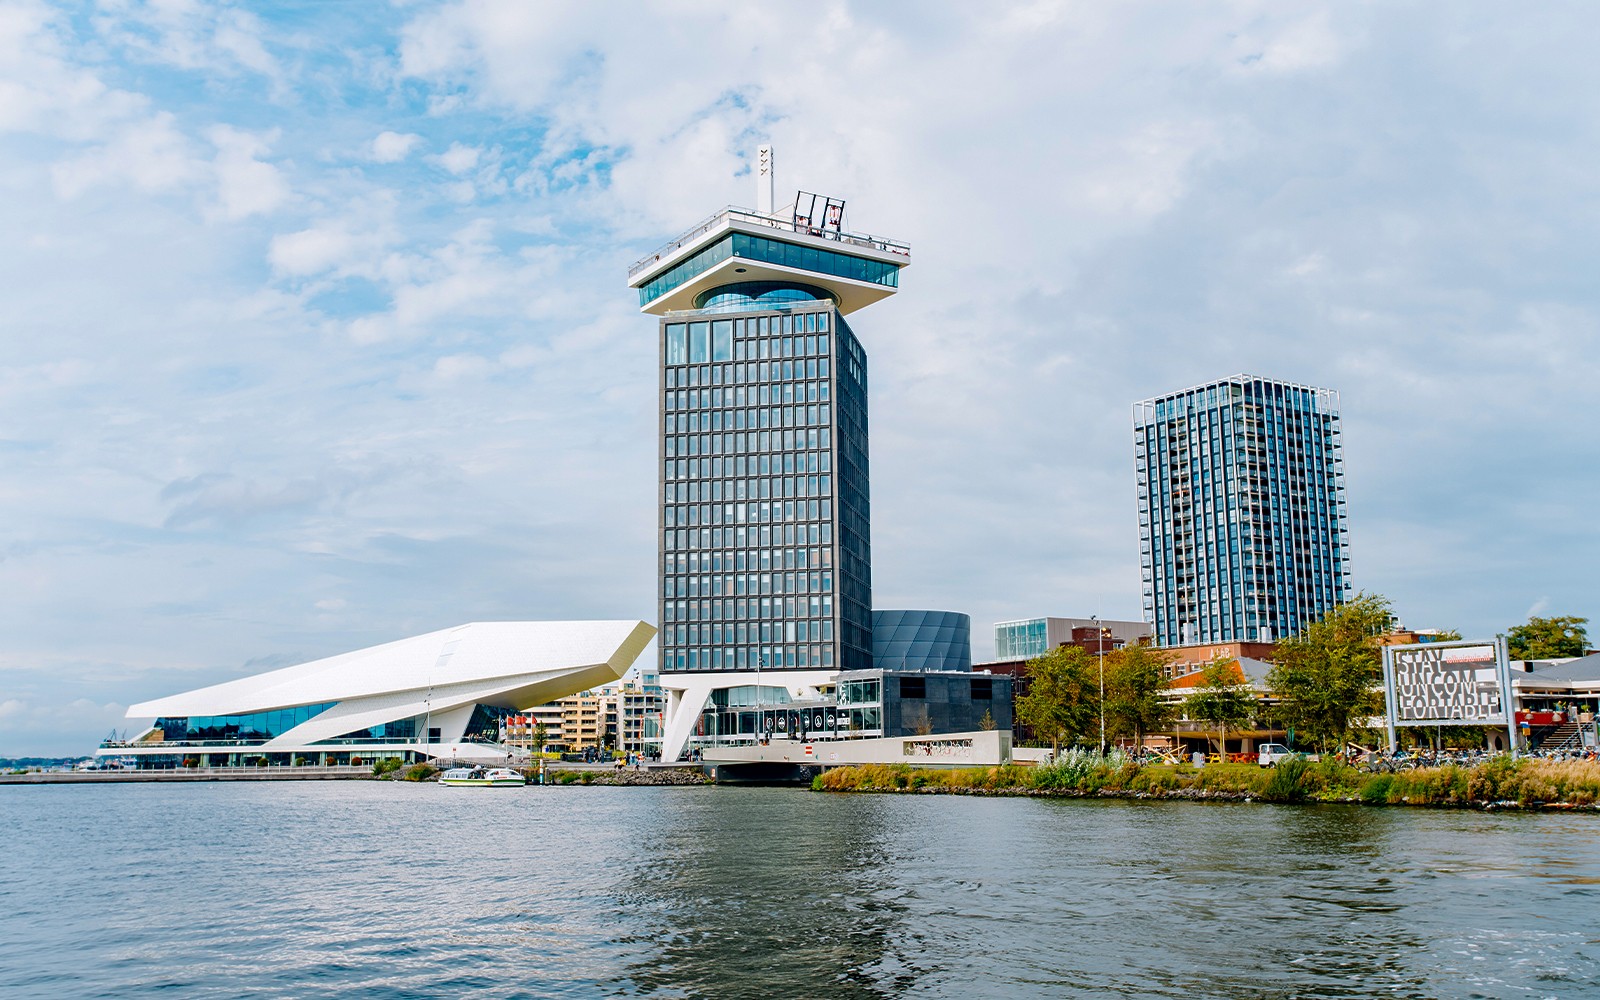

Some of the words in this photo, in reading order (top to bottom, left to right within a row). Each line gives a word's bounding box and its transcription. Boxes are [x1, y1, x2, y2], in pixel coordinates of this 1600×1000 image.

[1398, 649, 1443, 674] STAY
[1399, 670, 1477, 697] UNCOM
[1402, 692, 1498, 719] FORTABLE
